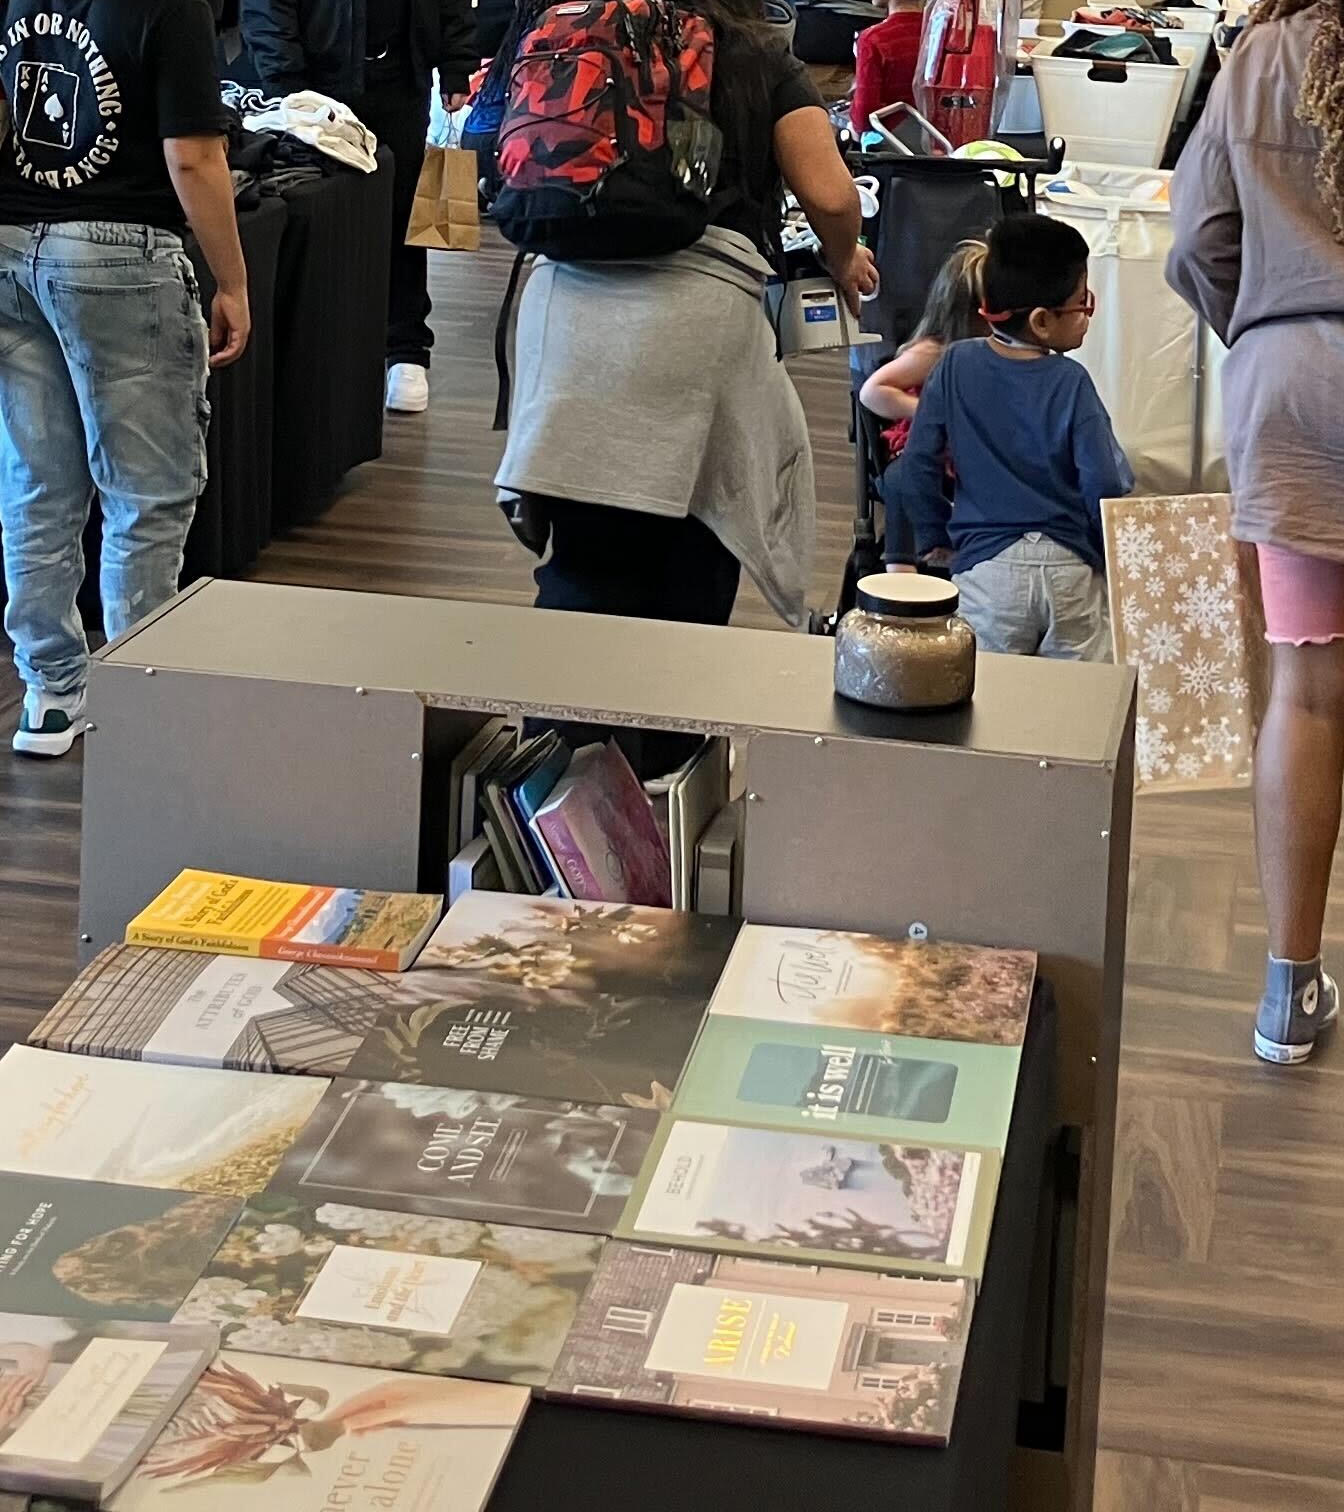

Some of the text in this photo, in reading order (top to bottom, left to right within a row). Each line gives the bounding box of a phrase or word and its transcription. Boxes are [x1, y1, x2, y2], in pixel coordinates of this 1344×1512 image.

[7, 13, 124, 117] IN OR NOTHING
[21, 67, 31, 80] K
[41, 71, 49, 85] A
[34, 134, 120, 190] CHANCE
[132, 931, 140, 941] A
[142, 932, 164, 943] Story
[166, 935, 174, 944] of
[175, 936, 199, 946] God's
[443, 1024, 471, 1047] FREE
[460, 1026, 490, 1054] FROM
[477, 1027, 510, 1061] SHAME
[801, 1044, 856, 1121] it is well
[417, 1122, 464, 1172] COME
[448, 1116, 503, 1192] AND SEE
[666, 1155, 693, 1196] BEHOLD
[11, 1227, 34, 1246] FOR
[25, 1201, 53, 1226] HOPE
[704, 1298, 753, 1366] ARISE
[363, 1440, 418, 1510] alone
